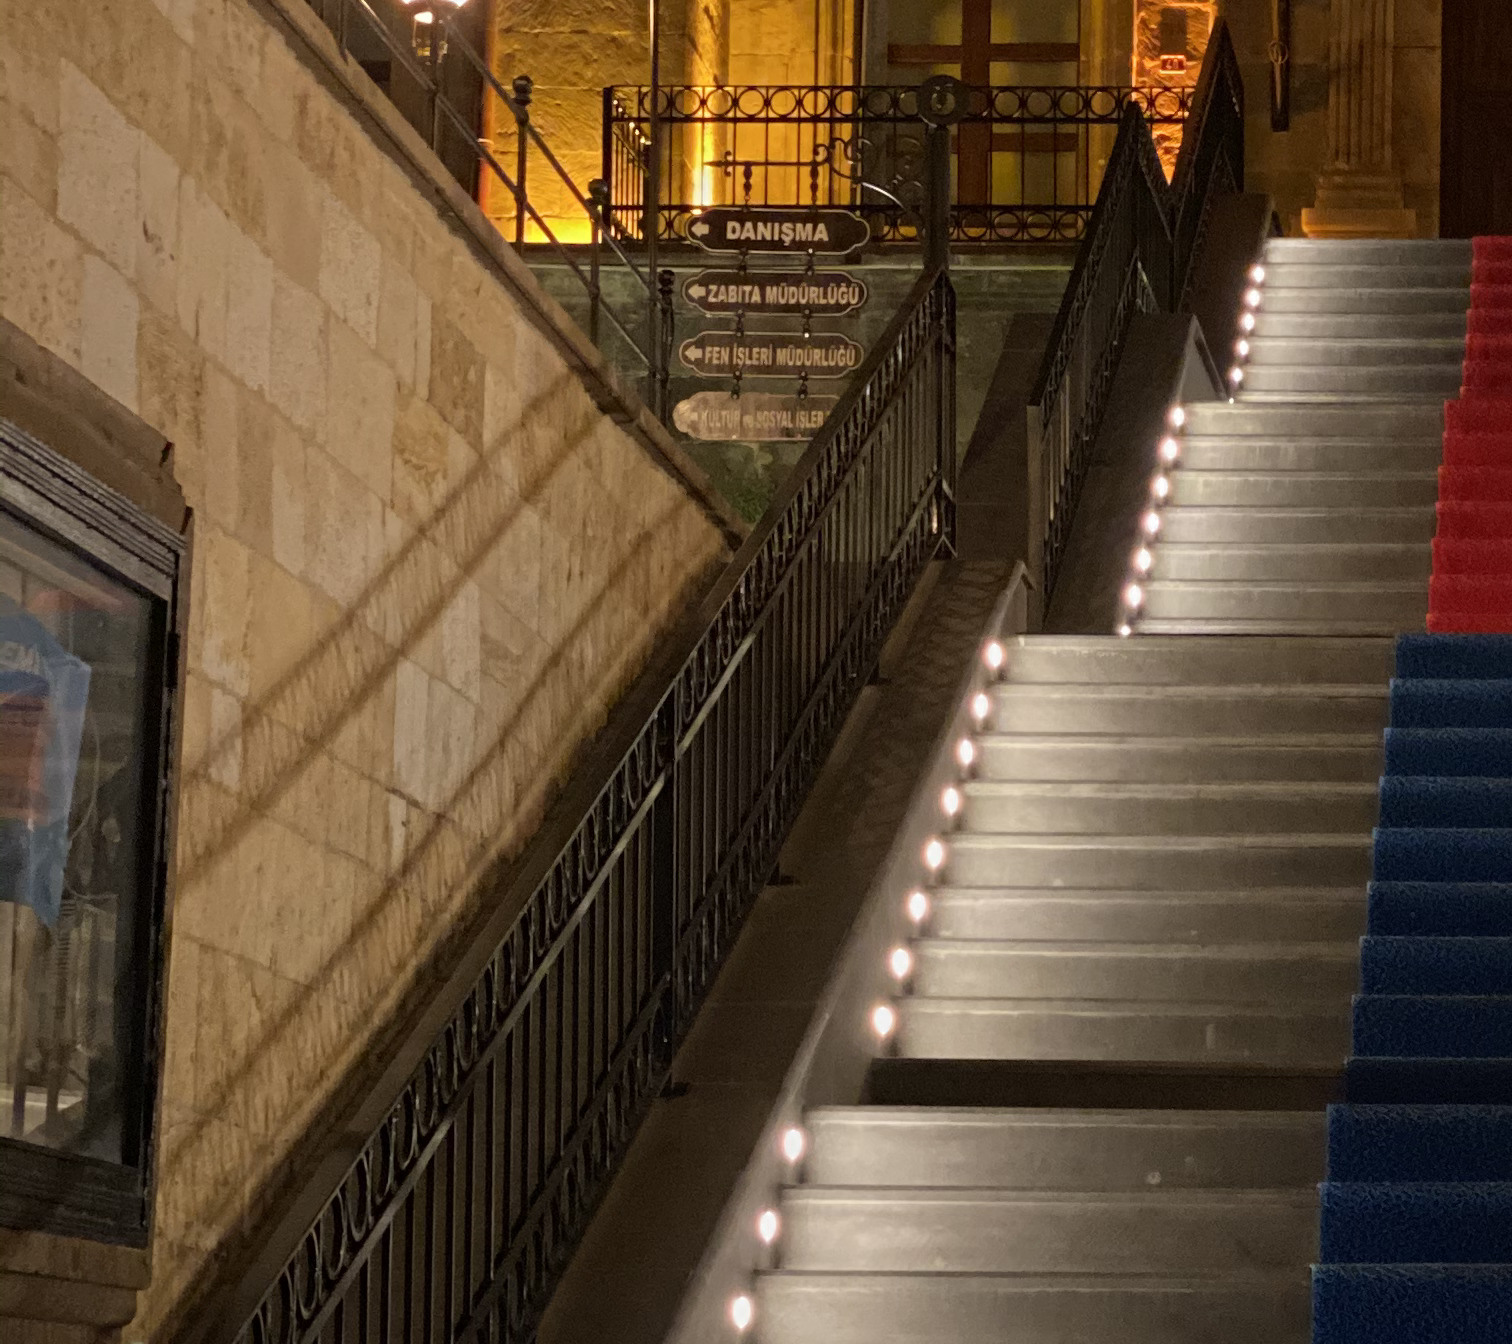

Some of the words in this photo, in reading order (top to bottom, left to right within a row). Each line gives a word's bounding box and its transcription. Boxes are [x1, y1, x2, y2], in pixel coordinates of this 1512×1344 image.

[725, 221, 829, 246] DANIŞMA
[707, 284, 762, 304] ZABITA
[765, 282, 860, 305] MÜDÜRLÜĞÜ
[704, 345, 731, 366] FEN
[732, 343, 773, 370] İŞLERİ
[775, 344, 856, 367] MÜDÜRLÜĞÜ
